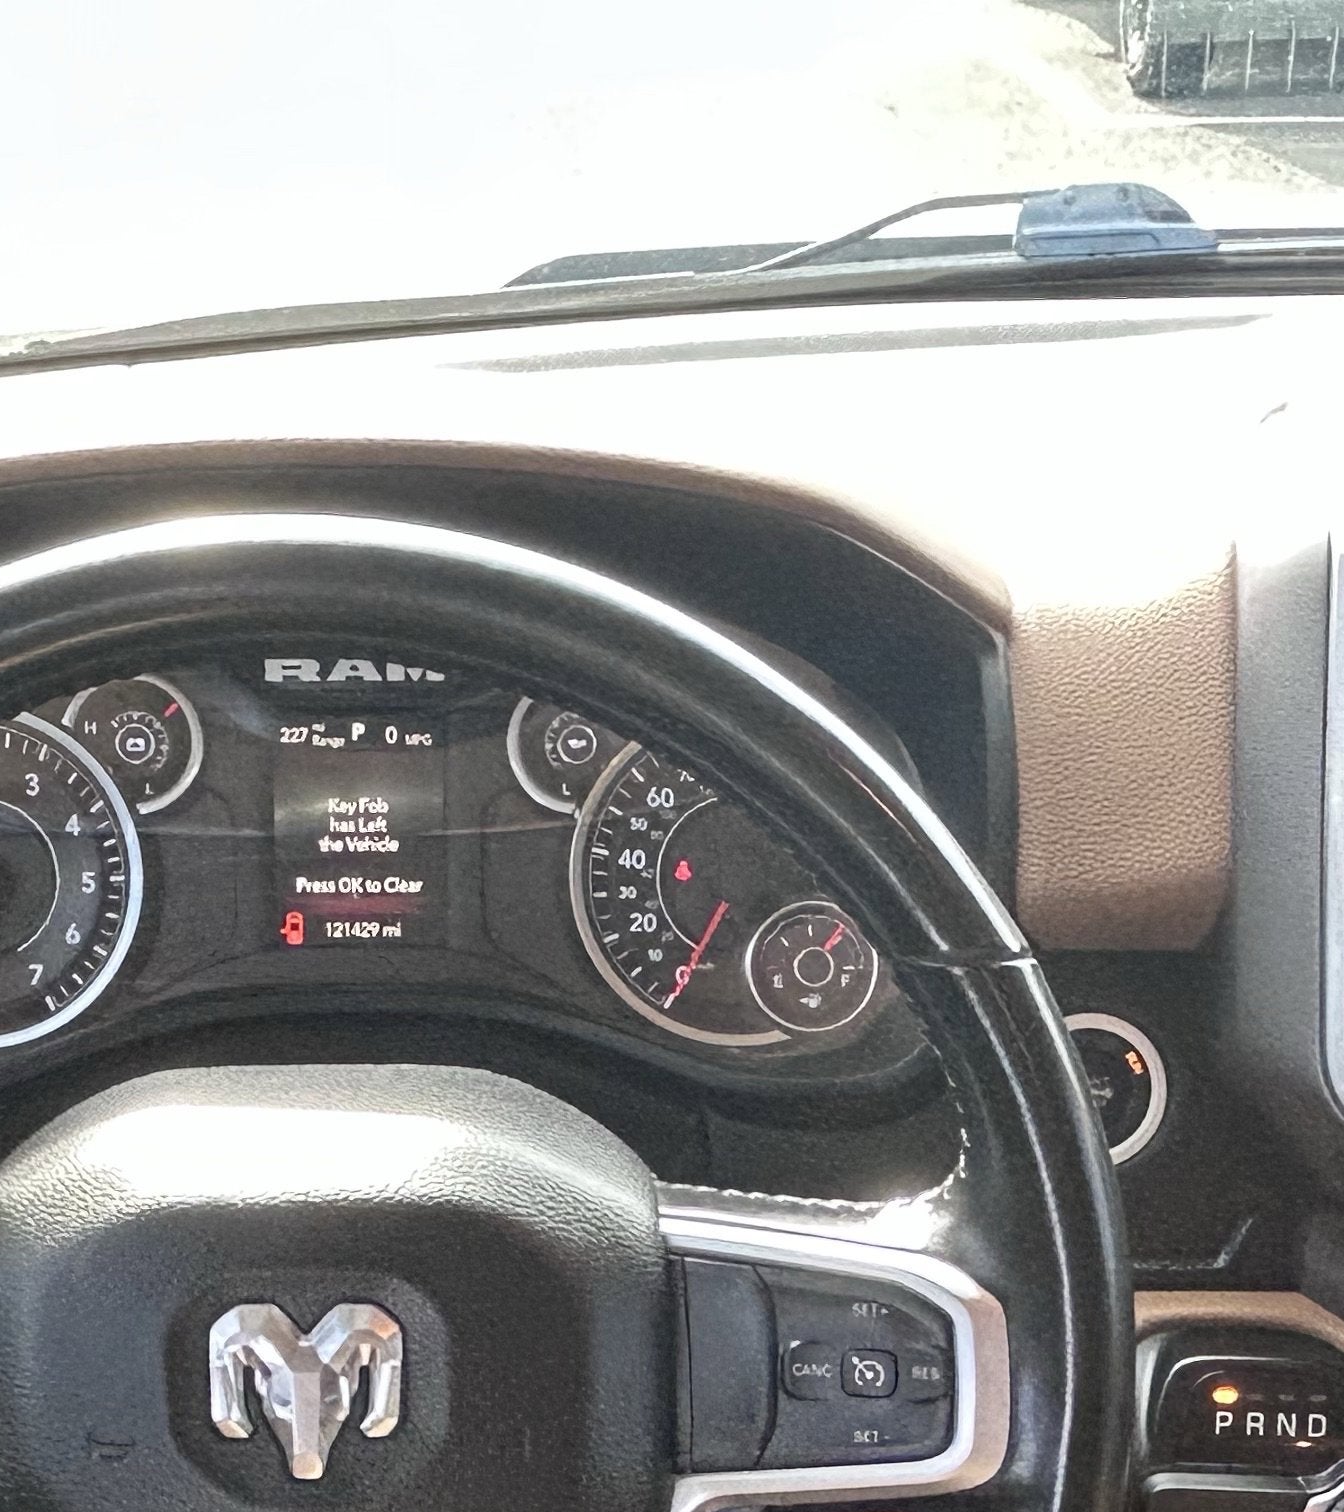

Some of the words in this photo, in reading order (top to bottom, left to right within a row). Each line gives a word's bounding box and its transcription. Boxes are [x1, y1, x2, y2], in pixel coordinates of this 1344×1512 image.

[264, 658, 445, 682] RAM
[84, 720, 97, 735] H
[280, 727, 308, 744] 227
[351, 722, 366, 742] P
[384, 725, 398, 745] 0
[24, 773, 40, 796] 3
[144, 782, 155, 795] L
[561, 782, 571, 796] L
[328, 798, 356, 816] Key
[358, 797, 389, 814] Fob
[646, 786, 675, 808] 60
[64, 813, 81, 836] 4
[329, 816, 355, 833] has
[358, 816, 387, 833] Left
[317, 835, 344, 852] the
[346, 836, 400, 852] Vehicle
[617, 849, 646, 870] 40
[81, 871, 96, 894] 5
[295, 877, 336, 894] Press
[338, 877, 363, 894] OK
[365, 879, 382, 894] to
[383, 877, 424, 894] Clear
[618, 886, 637, 900] 30
[325, 922, 380, 938] 121429
[382, 921, 402, 938] mi
[629, 912, 657, 933] 20
[65, 922, 81, 945] 6
[647, 948, 663, 962] 10
[28, 963, 44, 986] 7
[792, 1363, 834, 1379] CANC
